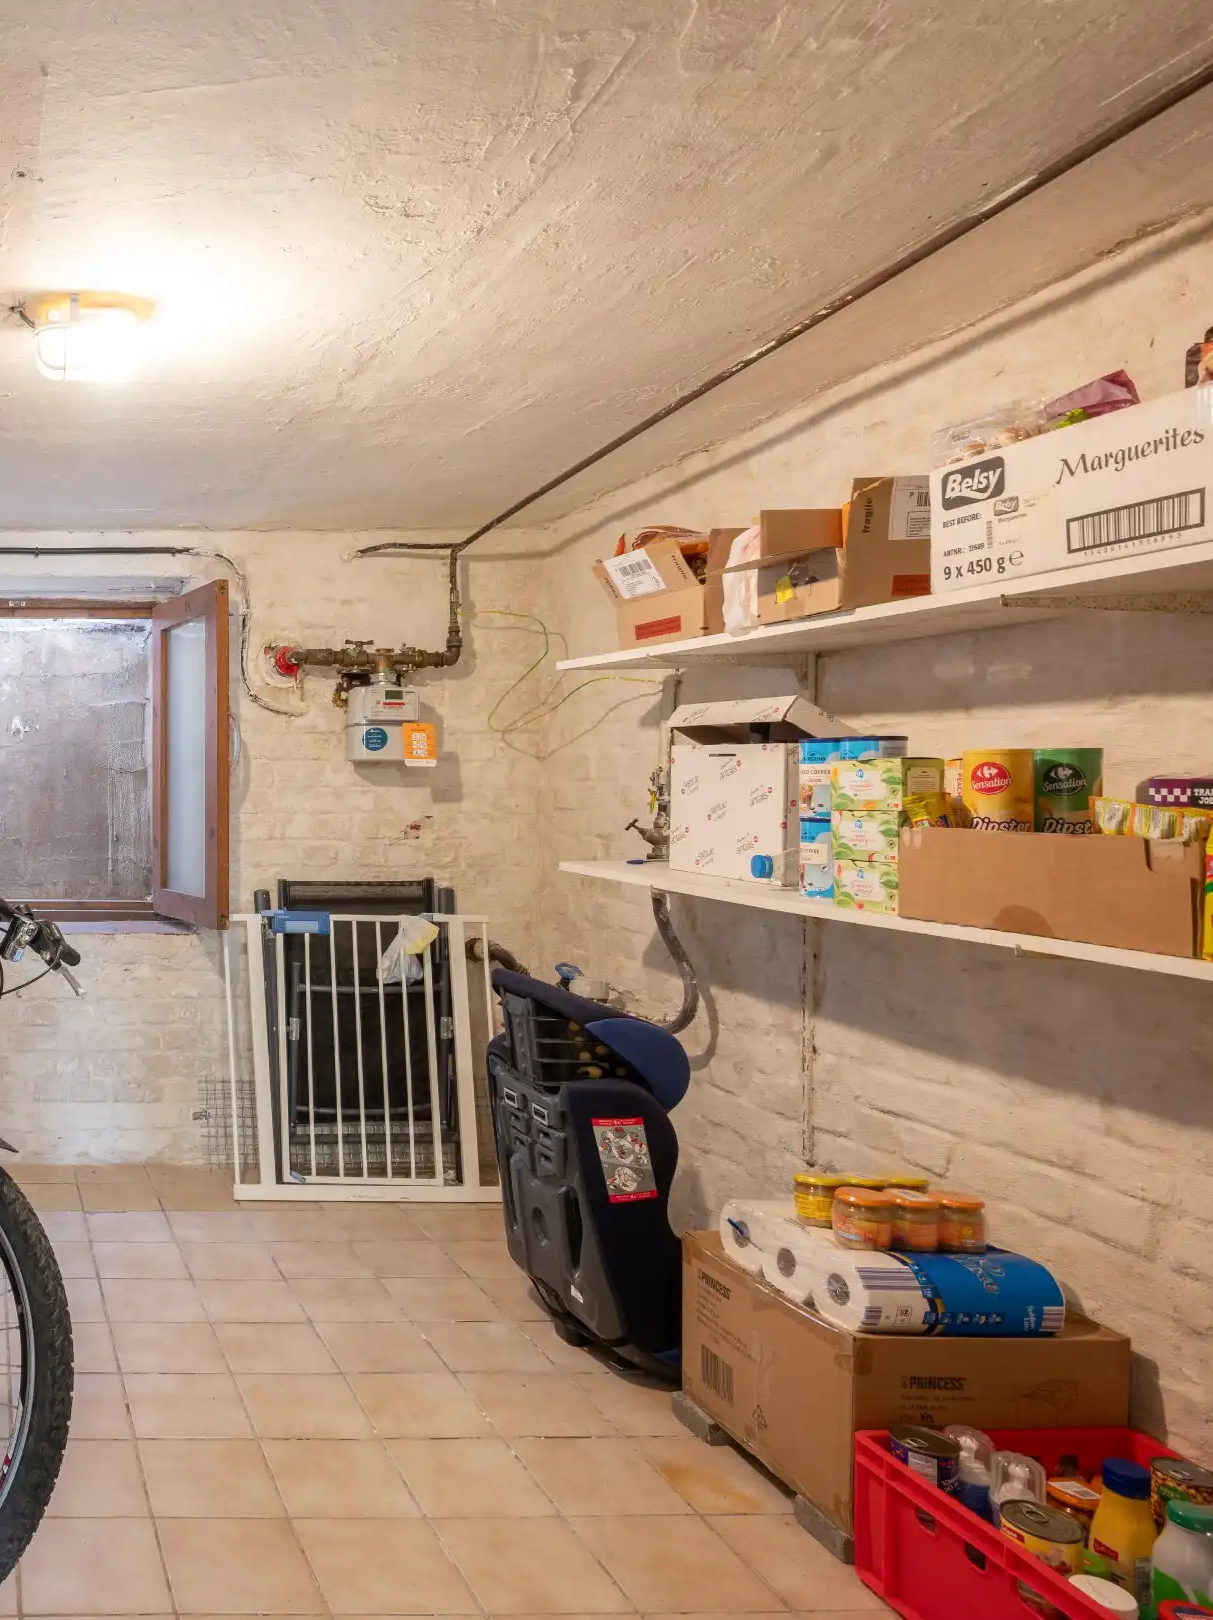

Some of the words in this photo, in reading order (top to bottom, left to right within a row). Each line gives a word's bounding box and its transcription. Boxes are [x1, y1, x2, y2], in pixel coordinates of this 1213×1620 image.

[1053, 428, 1205, 487] Marguerites
[945, 468, 1002, 500] Belsy
[862, 497, 874, 534] fragile
[942, 518, 956, 528] BEST
[956, 512, 982, 525] BEFORE:
[943, 566, 952, 580] 9
[955, 565, 964, 578] x
[967, 557, 992, 575] 450
[996, 556, 1006, 574] g
[971, 778, 1012, 790] Sensation
[1043, 778, 1087, 792] Sensation
[701, 1271, 732, 1300] PRINCESS
[909, 1375, 966, 1391] PRINCESS
